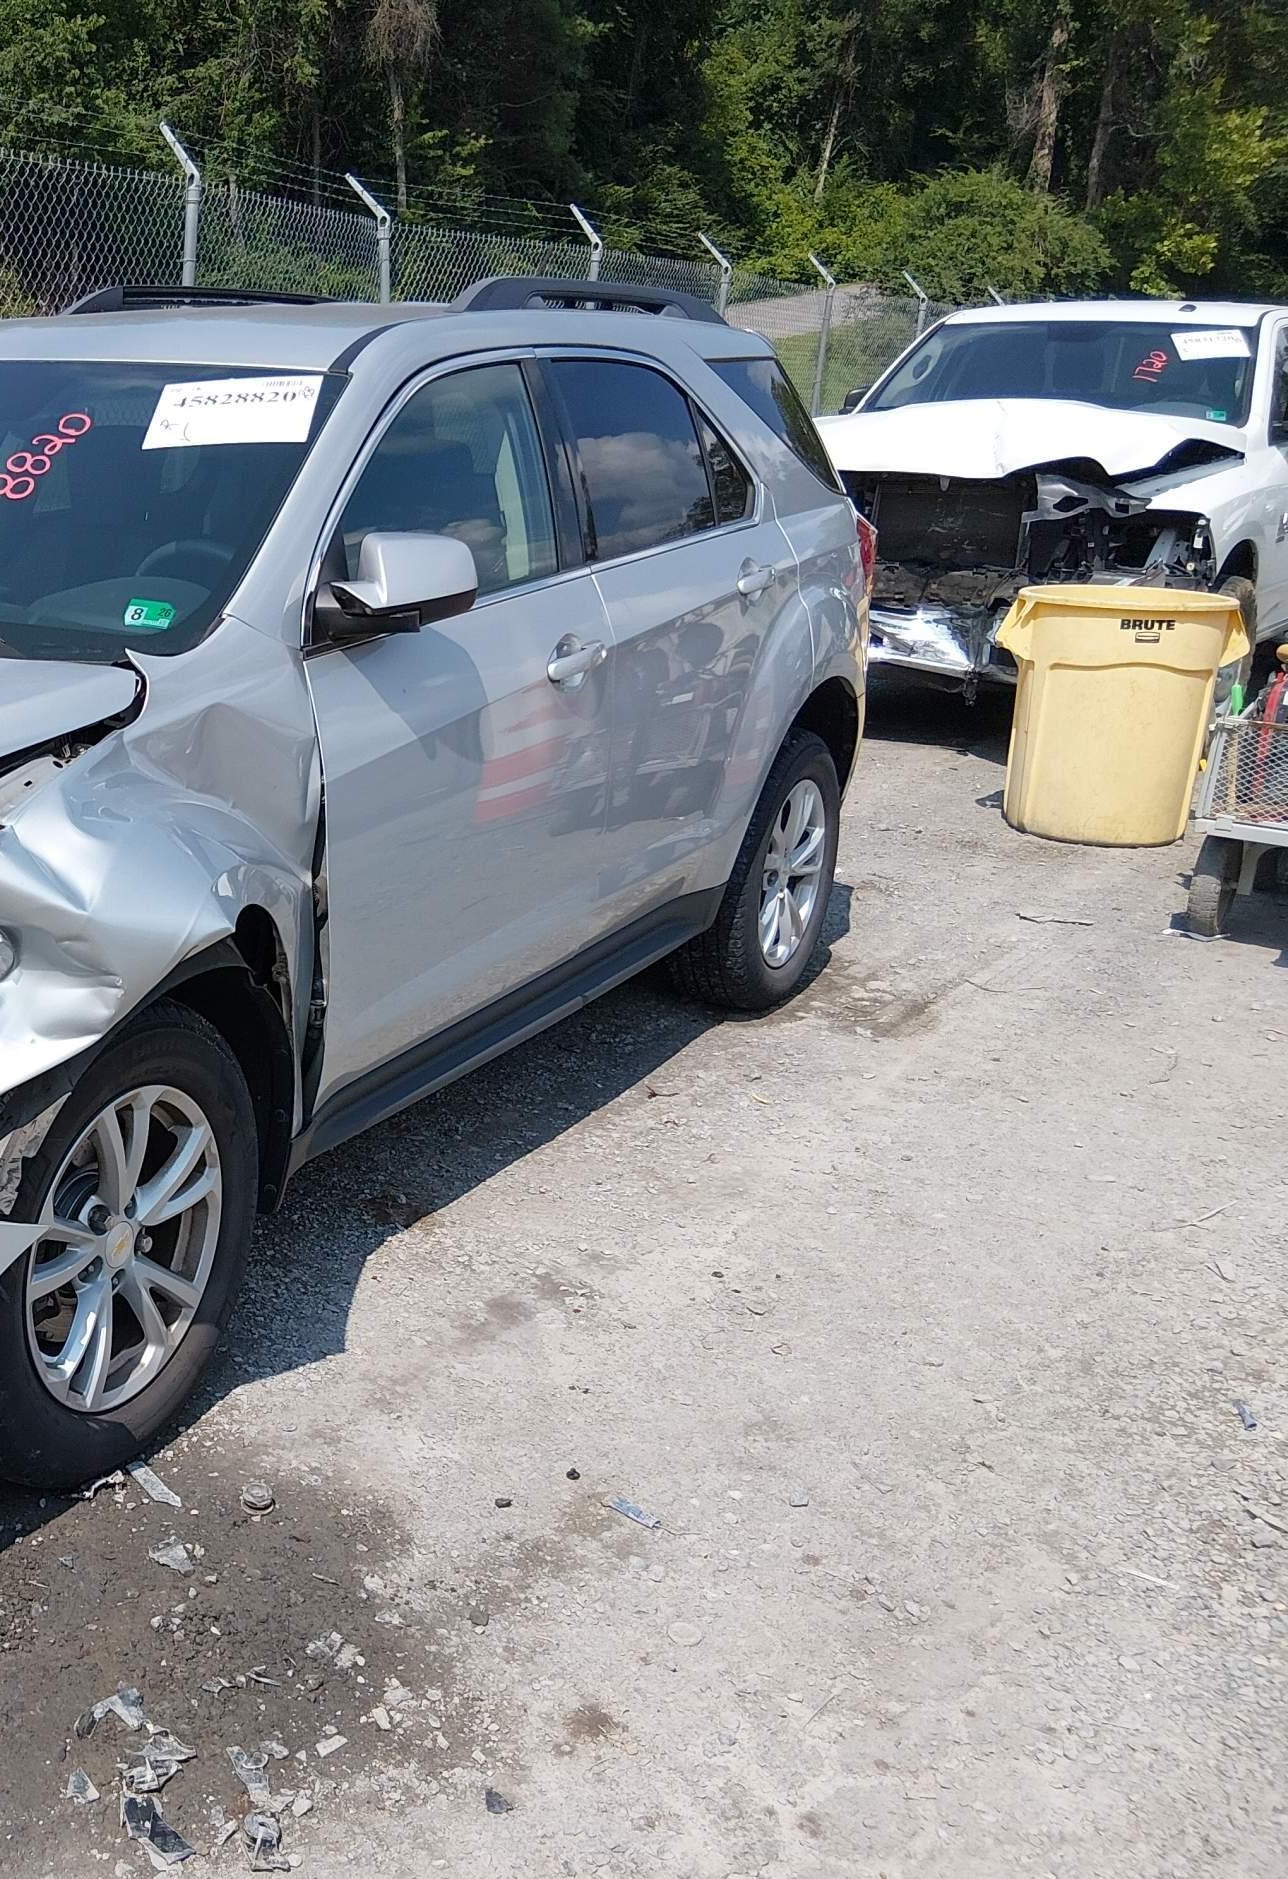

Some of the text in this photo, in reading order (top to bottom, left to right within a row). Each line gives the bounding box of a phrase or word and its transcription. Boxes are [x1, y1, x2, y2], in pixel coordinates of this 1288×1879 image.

[173, 391, 297, 408] 45828820
[131, 608, 144, 620] 8
[1120, 618, 1176, 631] BRUTE
